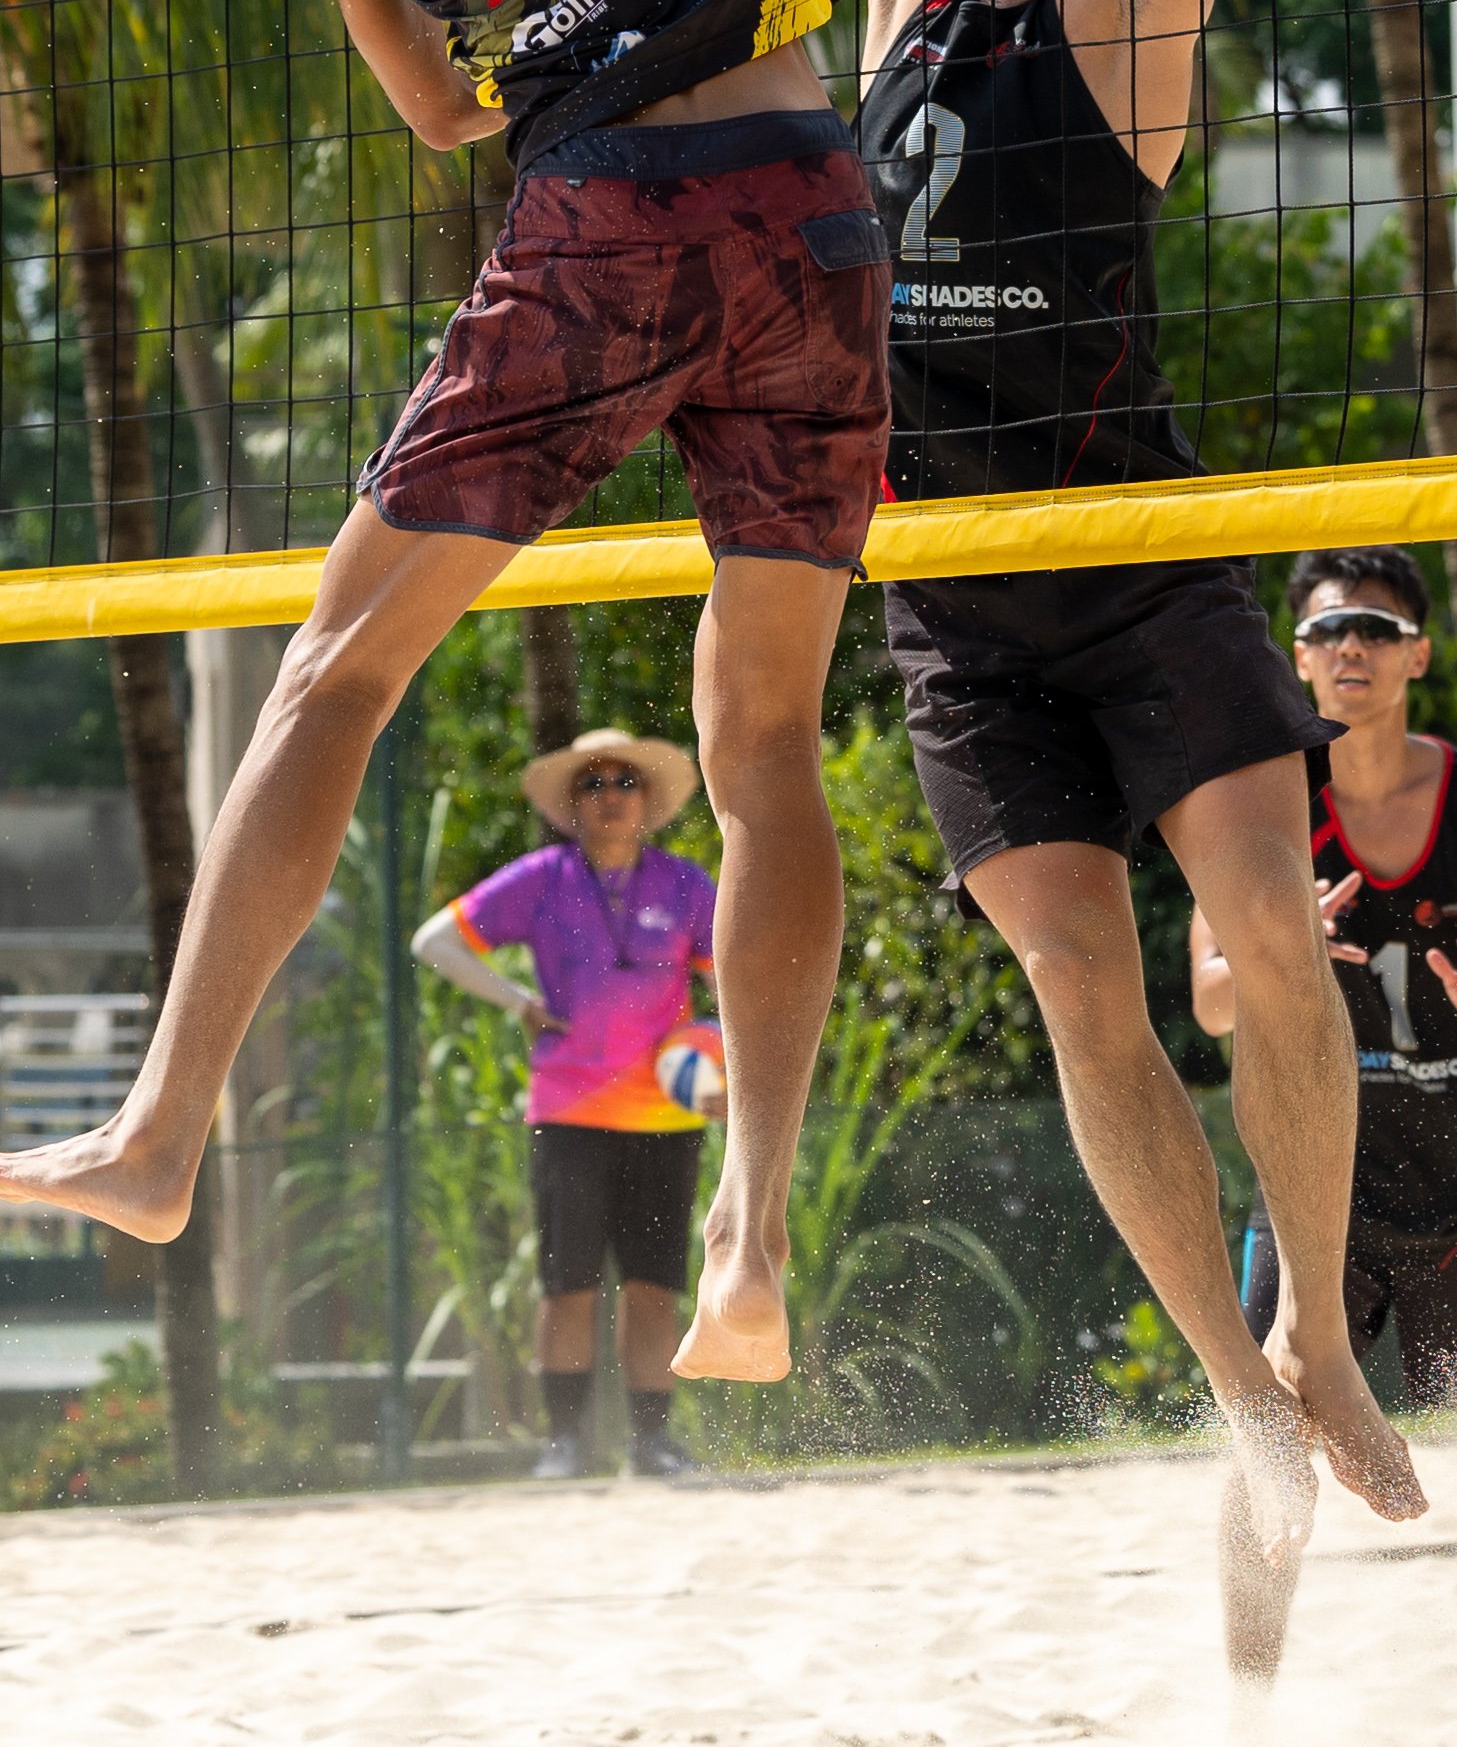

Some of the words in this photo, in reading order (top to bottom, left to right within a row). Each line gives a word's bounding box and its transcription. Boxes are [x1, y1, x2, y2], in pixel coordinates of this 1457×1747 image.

[901, 102, 965, 262] 2
[919, 312, 935, 326] for
[939, 313, 995, 327] athletes
[1369, 941, 1418, 1051] 1
